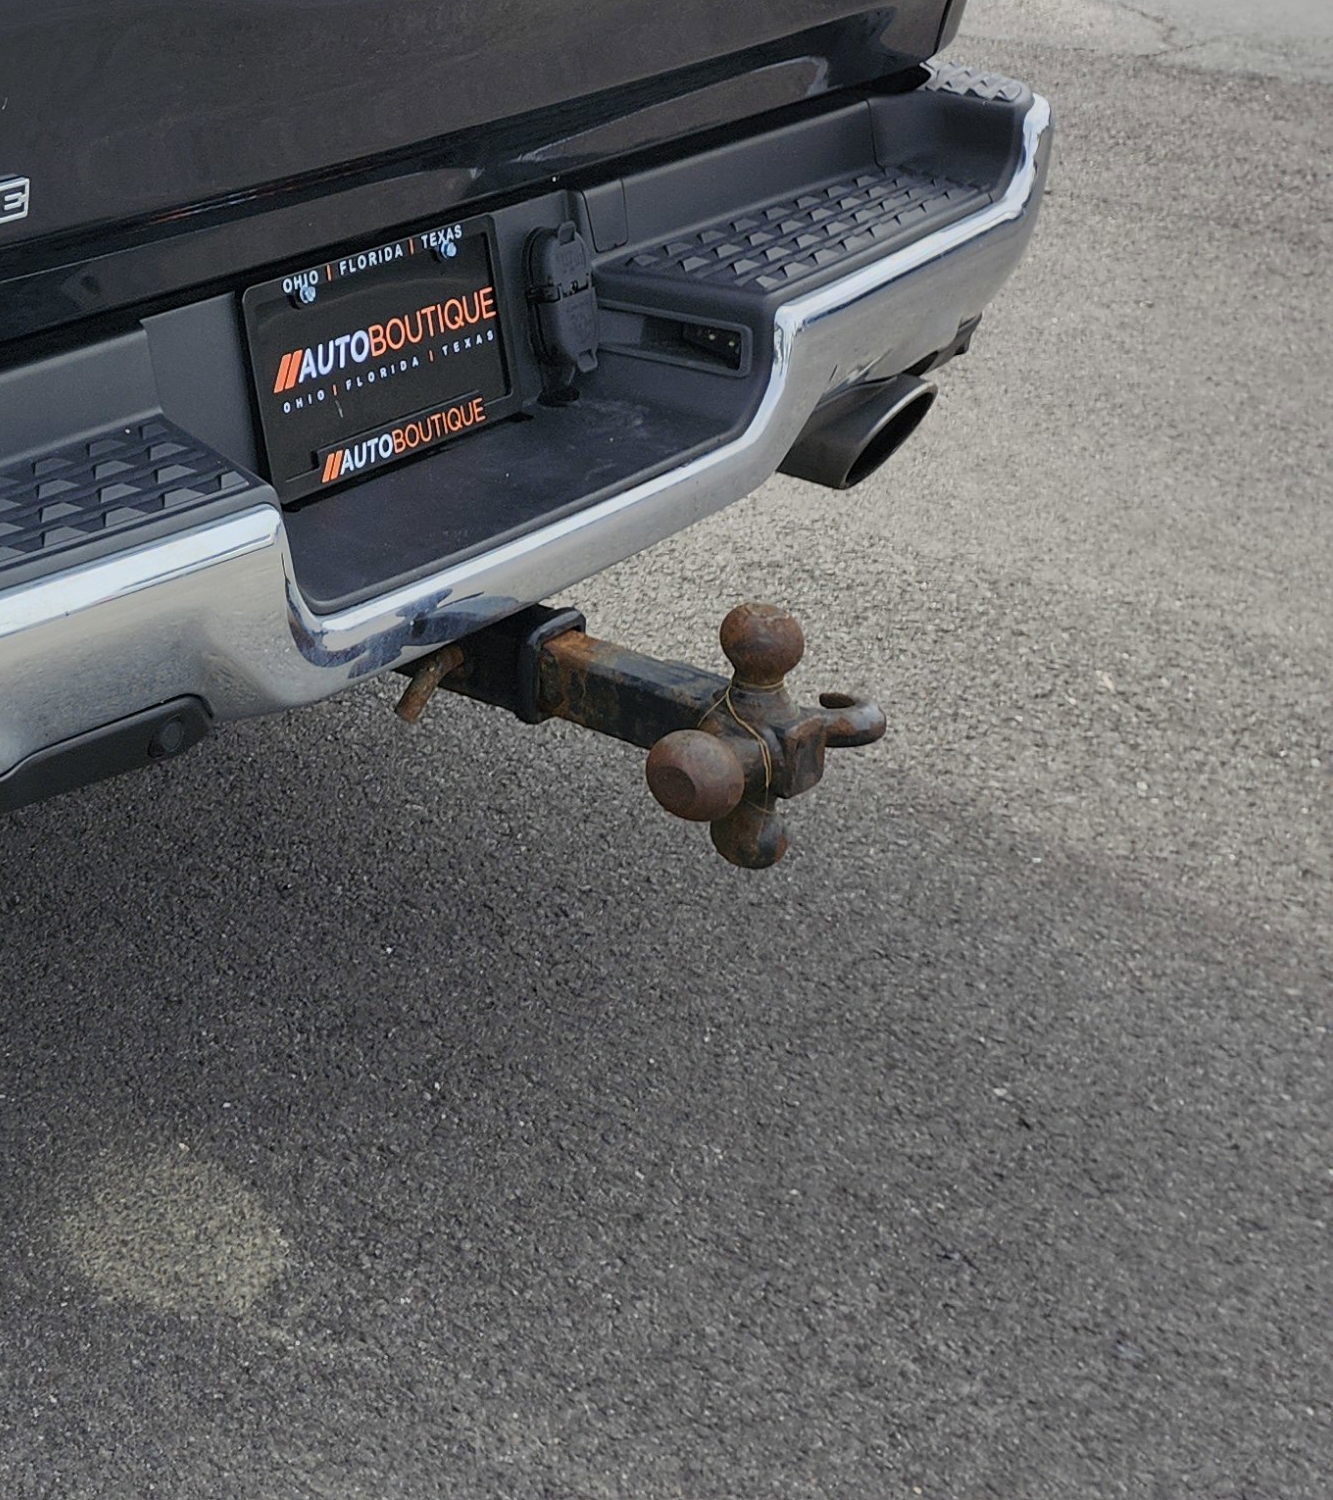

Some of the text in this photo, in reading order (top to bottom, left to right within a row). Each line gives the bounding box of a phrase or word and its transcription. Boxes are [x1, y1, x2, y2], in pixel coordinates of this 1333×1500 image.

[282, 224, 463, 294] OHIO FLORIDA TEXAS
[283, 329, 495, 414] OHIO FLORIDA TEXAS
